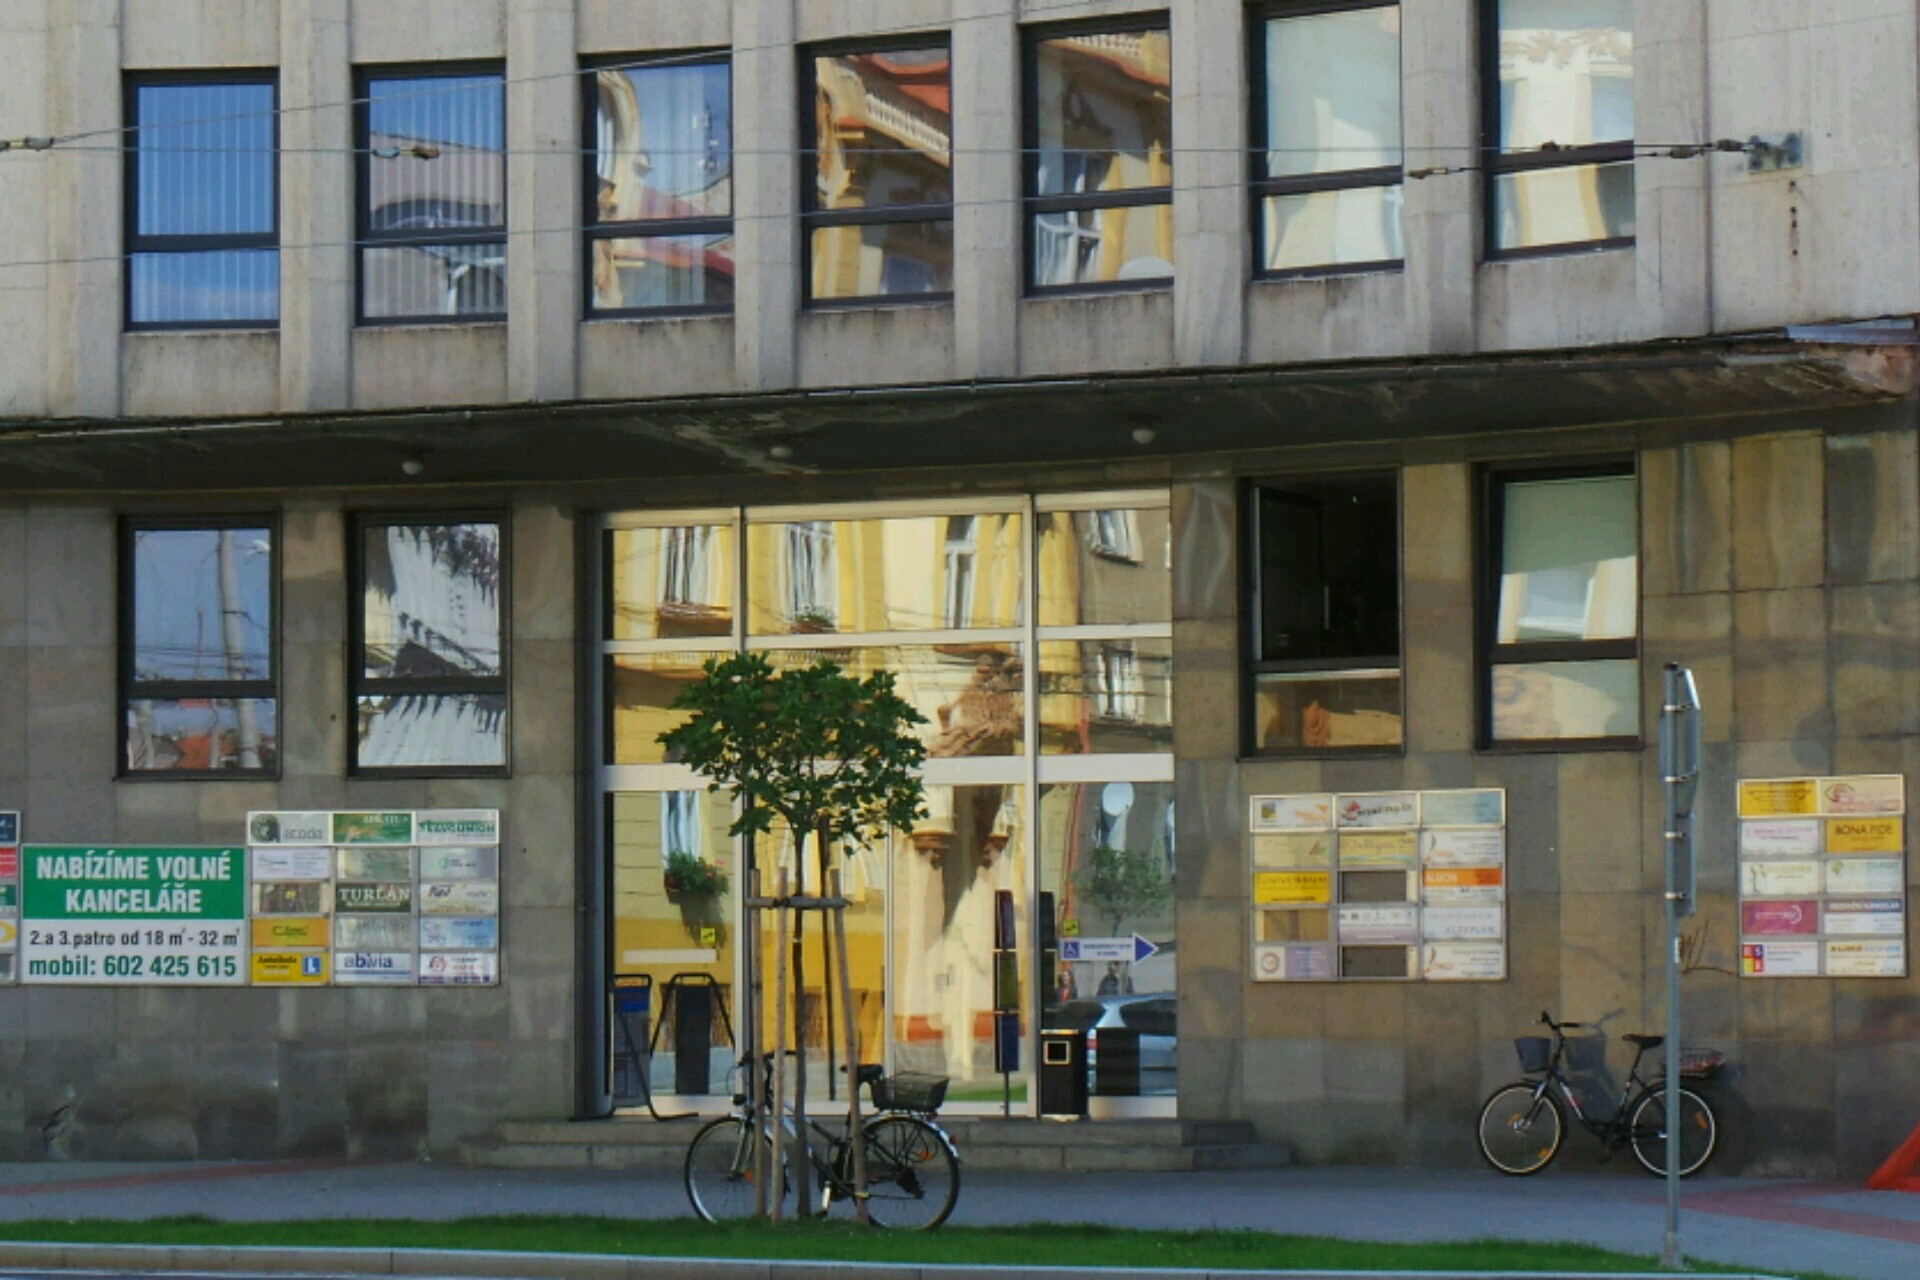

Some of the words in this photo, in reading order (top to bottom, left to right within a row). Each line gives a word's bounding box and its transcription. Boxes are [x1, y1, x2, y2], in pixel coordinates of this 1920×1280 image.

[36, 850, 149, 880] NABÍZÍME
[157, 850, 231, 881] VOLNÉ
[66, 882, 202, 913] KANCELÁŘE
[121, 930, 139, 945] od
[145, 930, 164, 945] 18
[199, 930, 219, 945] 32
[29, 955, 96, 976] mobil:
[103, 955, 143, 976] 602
[150, 955, 189, 976] 425
[197, 955, 236, 976] 615
